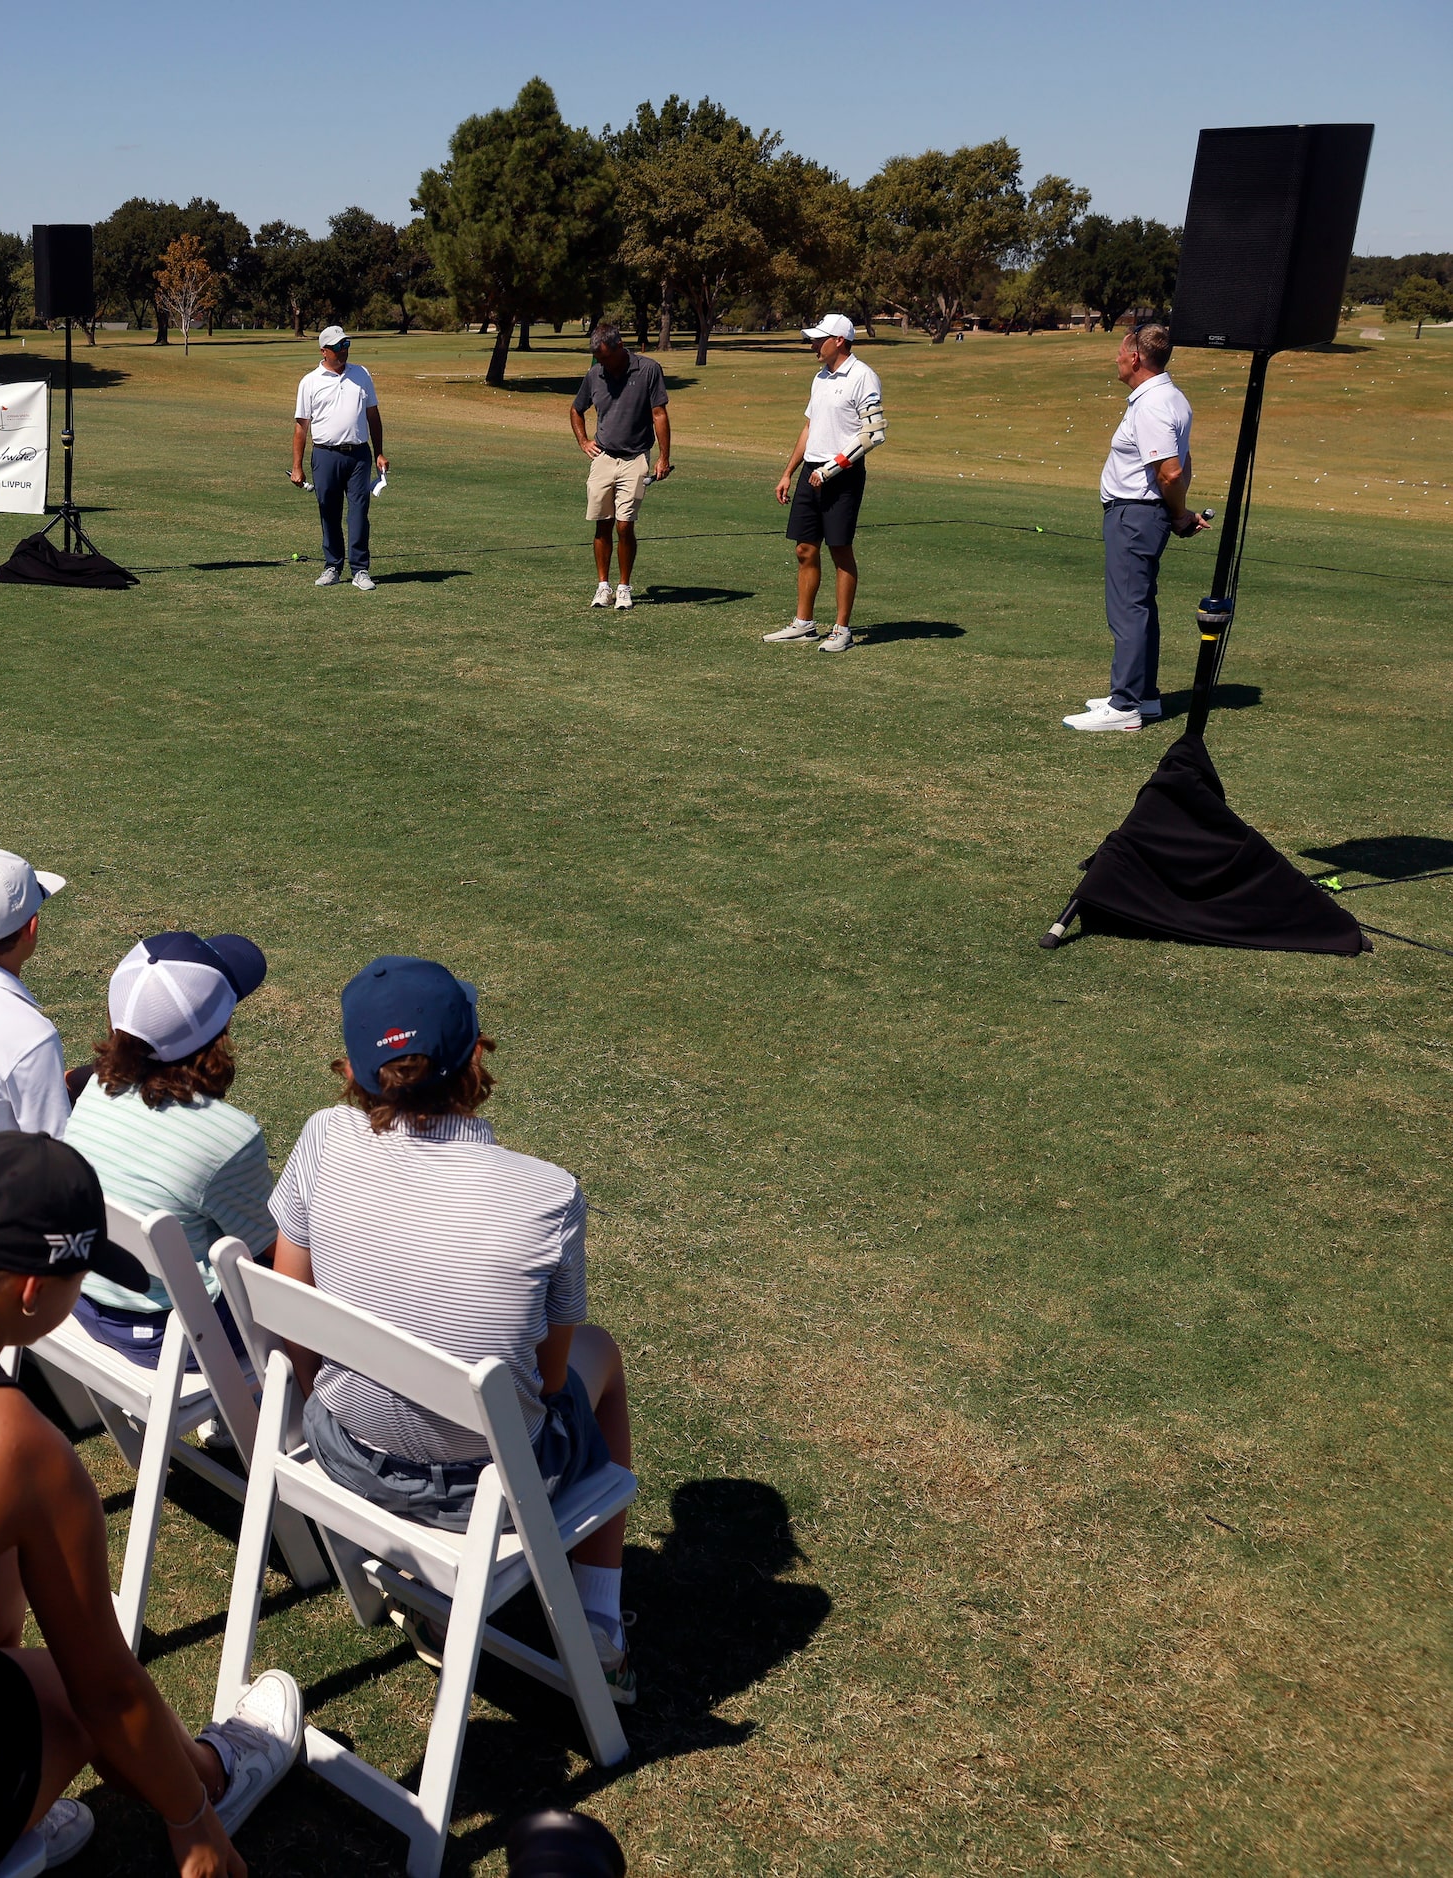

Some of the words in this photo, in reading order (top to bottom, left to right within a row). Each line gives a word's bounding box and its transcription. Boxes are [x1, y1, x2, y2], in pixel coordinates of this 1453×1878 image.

[0, 446, 37, 461] Invited
[1, 480, 32, 489] LIVPUR
[376, 1030, 417, 1047] ODYSSEY
[43, 1228, 98, 1264] PXG
